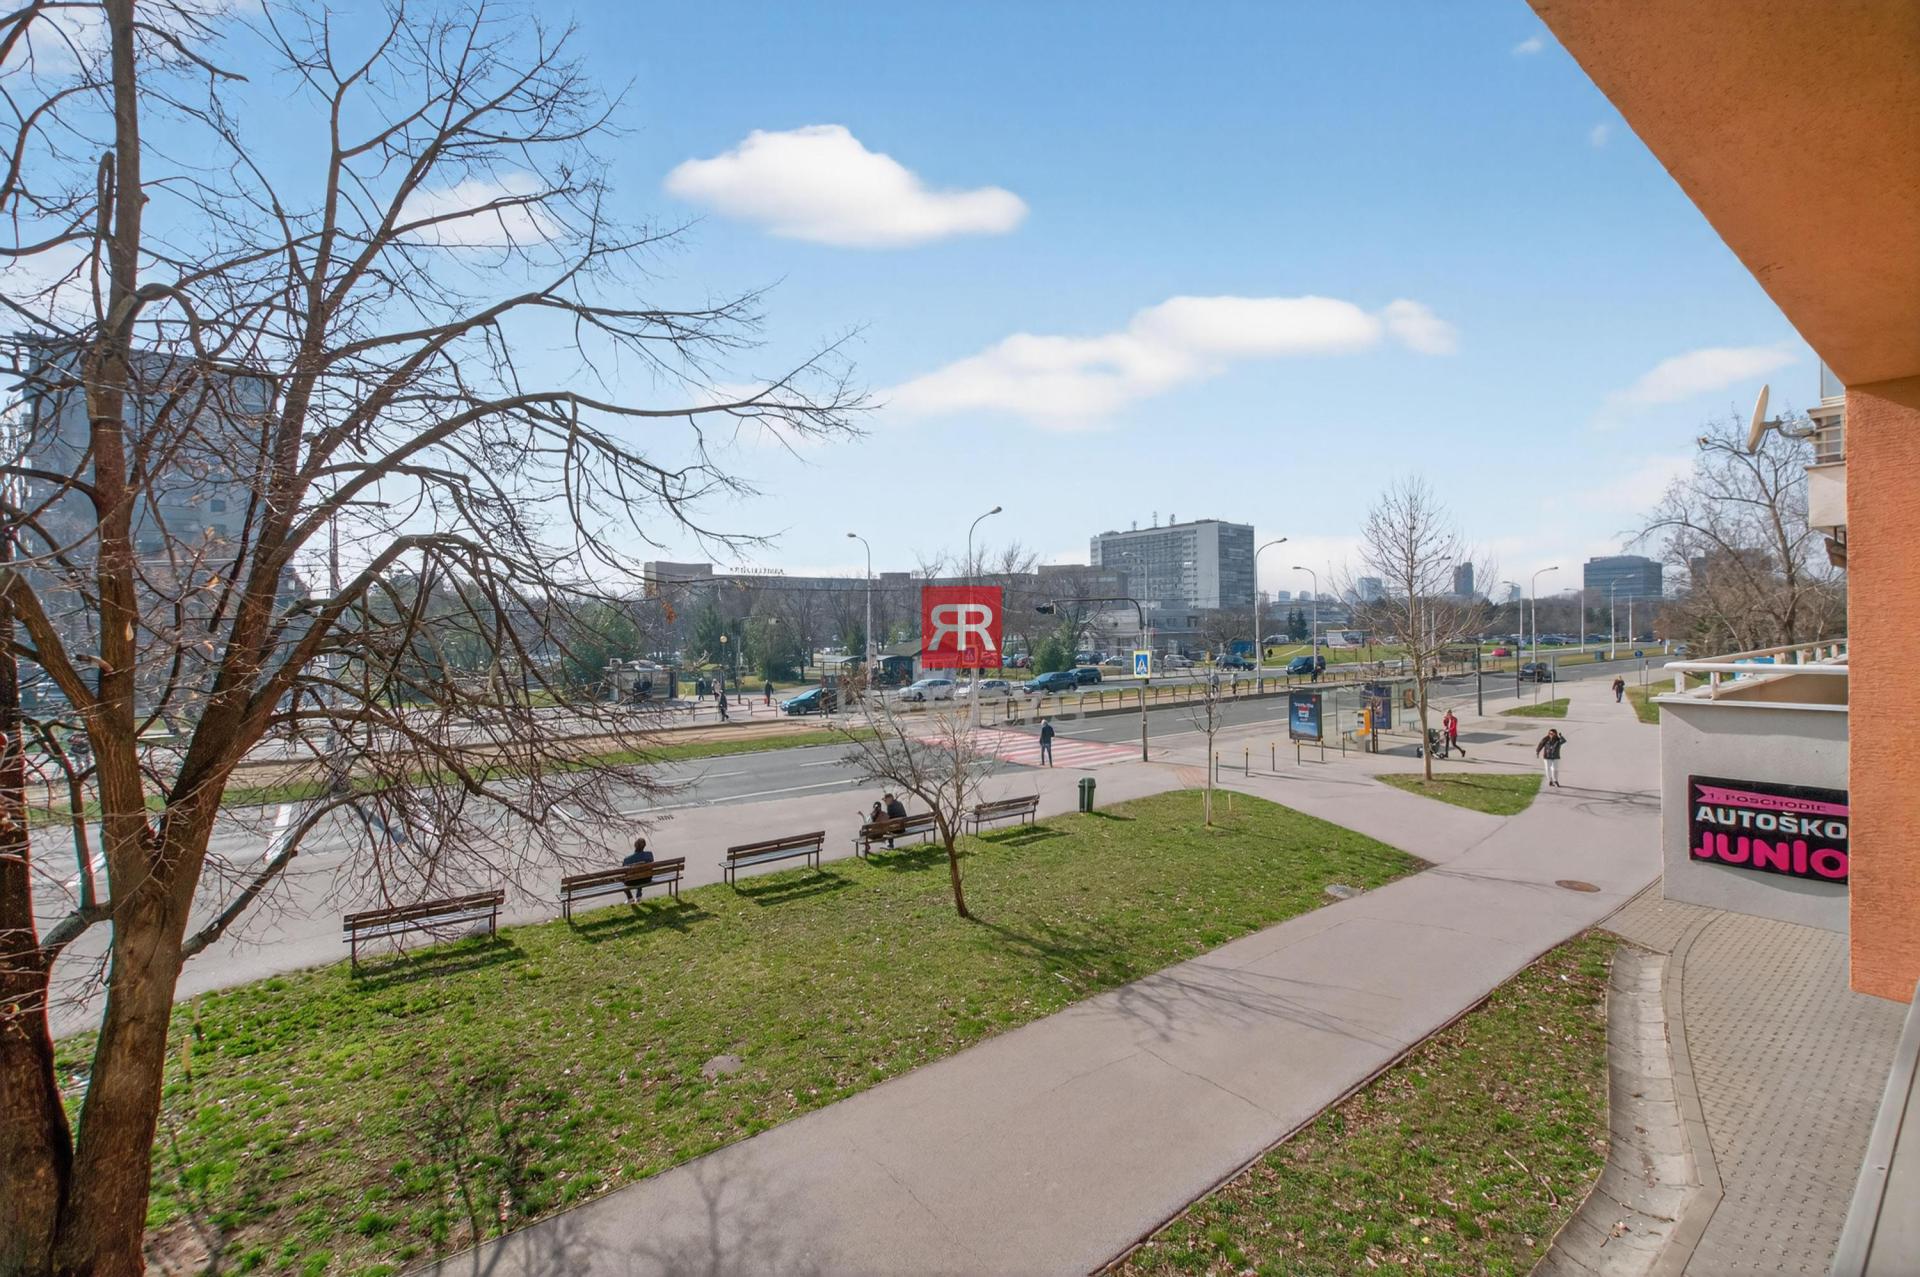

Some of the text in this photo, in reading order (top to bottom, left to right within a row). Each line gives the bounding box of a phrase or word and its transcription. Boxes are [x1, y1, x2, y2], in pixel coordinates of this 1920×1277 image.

[1708, 792, 1827, 812] 1. POSCHODIE
[1695, 806, 1848, 840] AUTOŠKO
